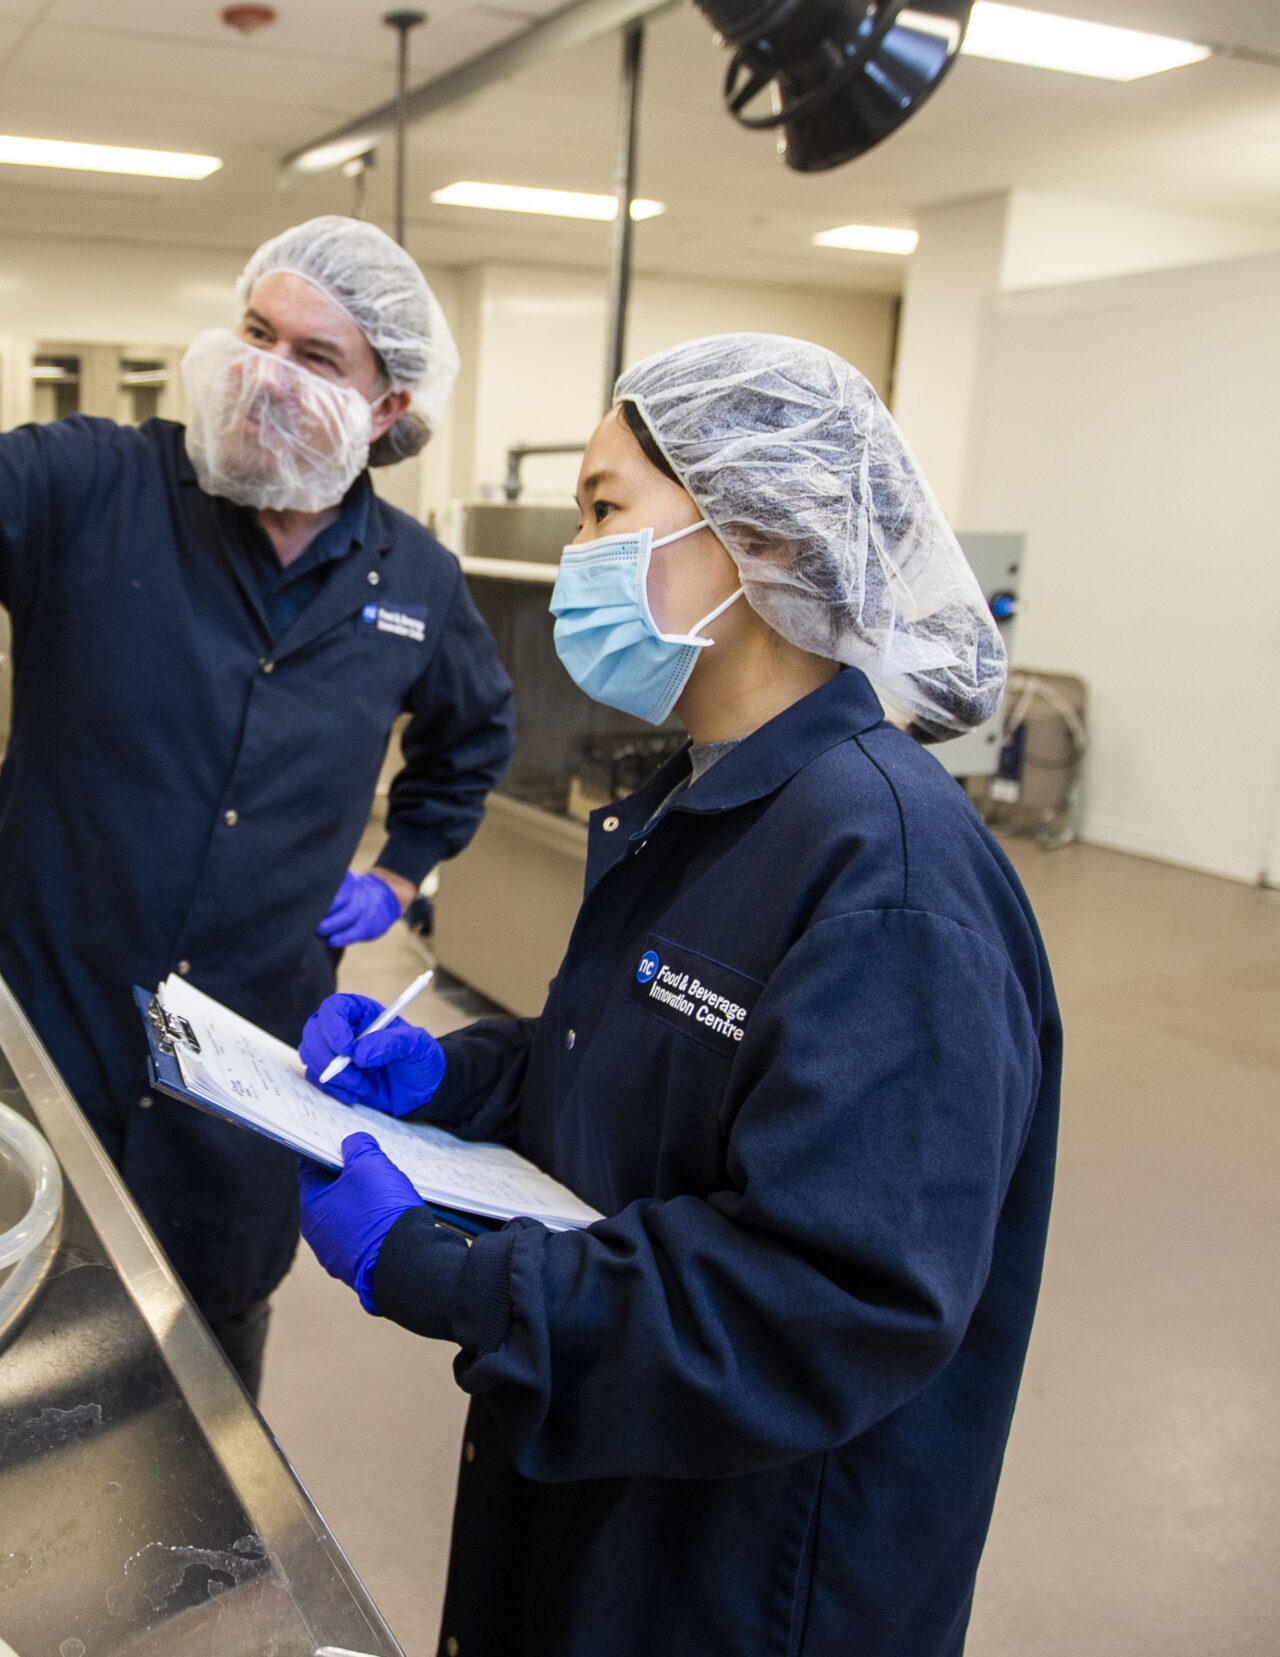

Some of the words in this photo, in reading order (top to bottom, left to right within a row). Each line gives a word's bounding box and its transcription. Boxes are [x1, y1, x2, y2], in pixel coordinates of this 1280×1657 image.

[639, 958, 655, 976] nc
[656, 965, 683, 988] Food
[678, 974, 690, 992] &
[687, 979, 747, 1021] Beverage
[649, 981, 695, 1016] Innovation
[695, 1005, 745, 1042] Centre
